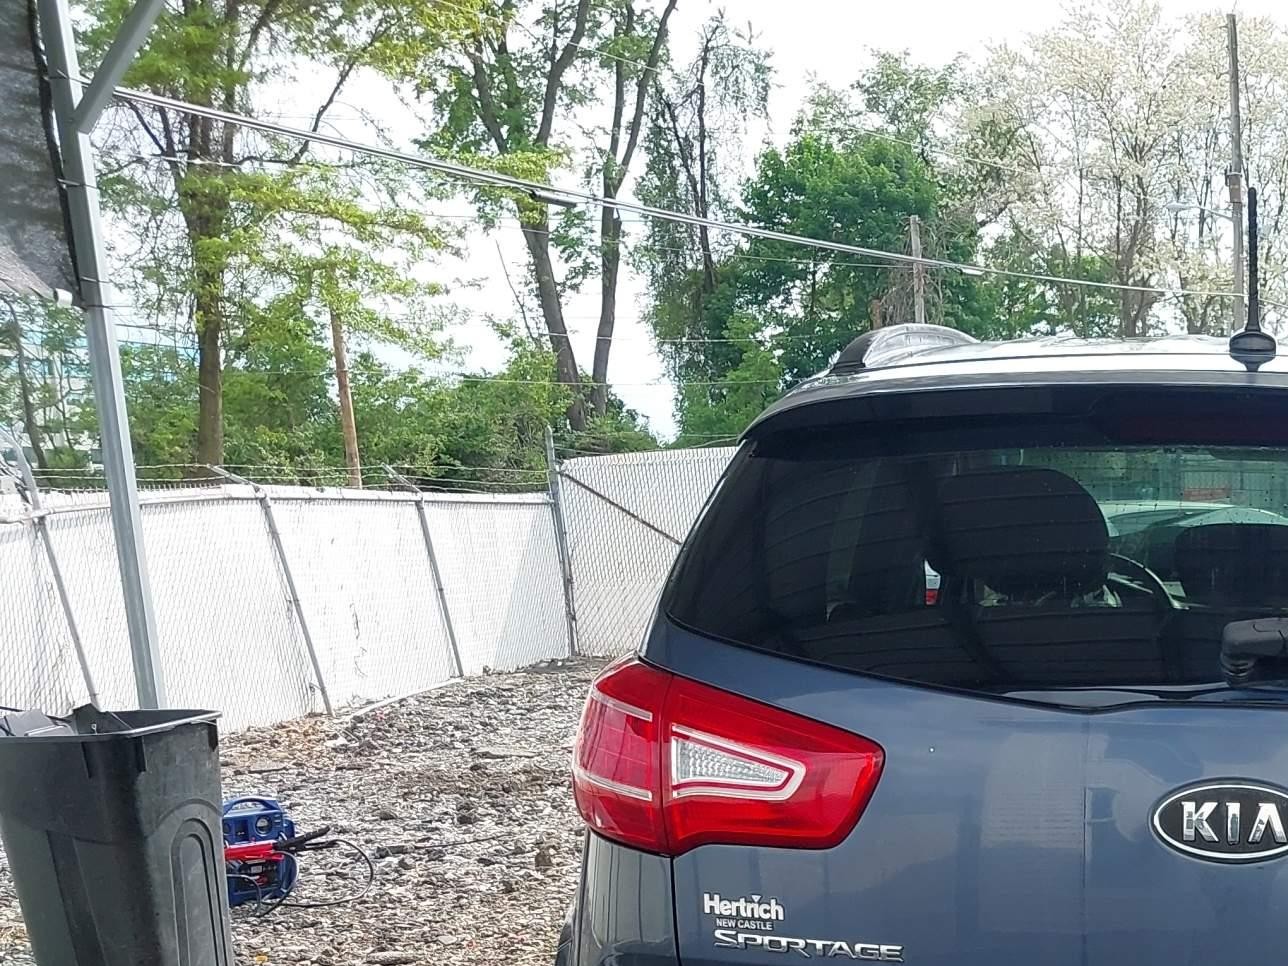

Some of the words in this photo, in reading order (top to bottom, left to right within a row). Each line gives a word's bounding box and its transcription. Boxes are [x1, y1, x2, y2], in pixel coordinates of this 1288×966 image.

[1181, 801, 1288, 845] KIA
[703, 892, 785, 921] Hertrich
[716, 918, 736, 929] NEW
[737, 919, 774, 931] CASTLE
[714, 929, 905, 963] SPORTAGE
